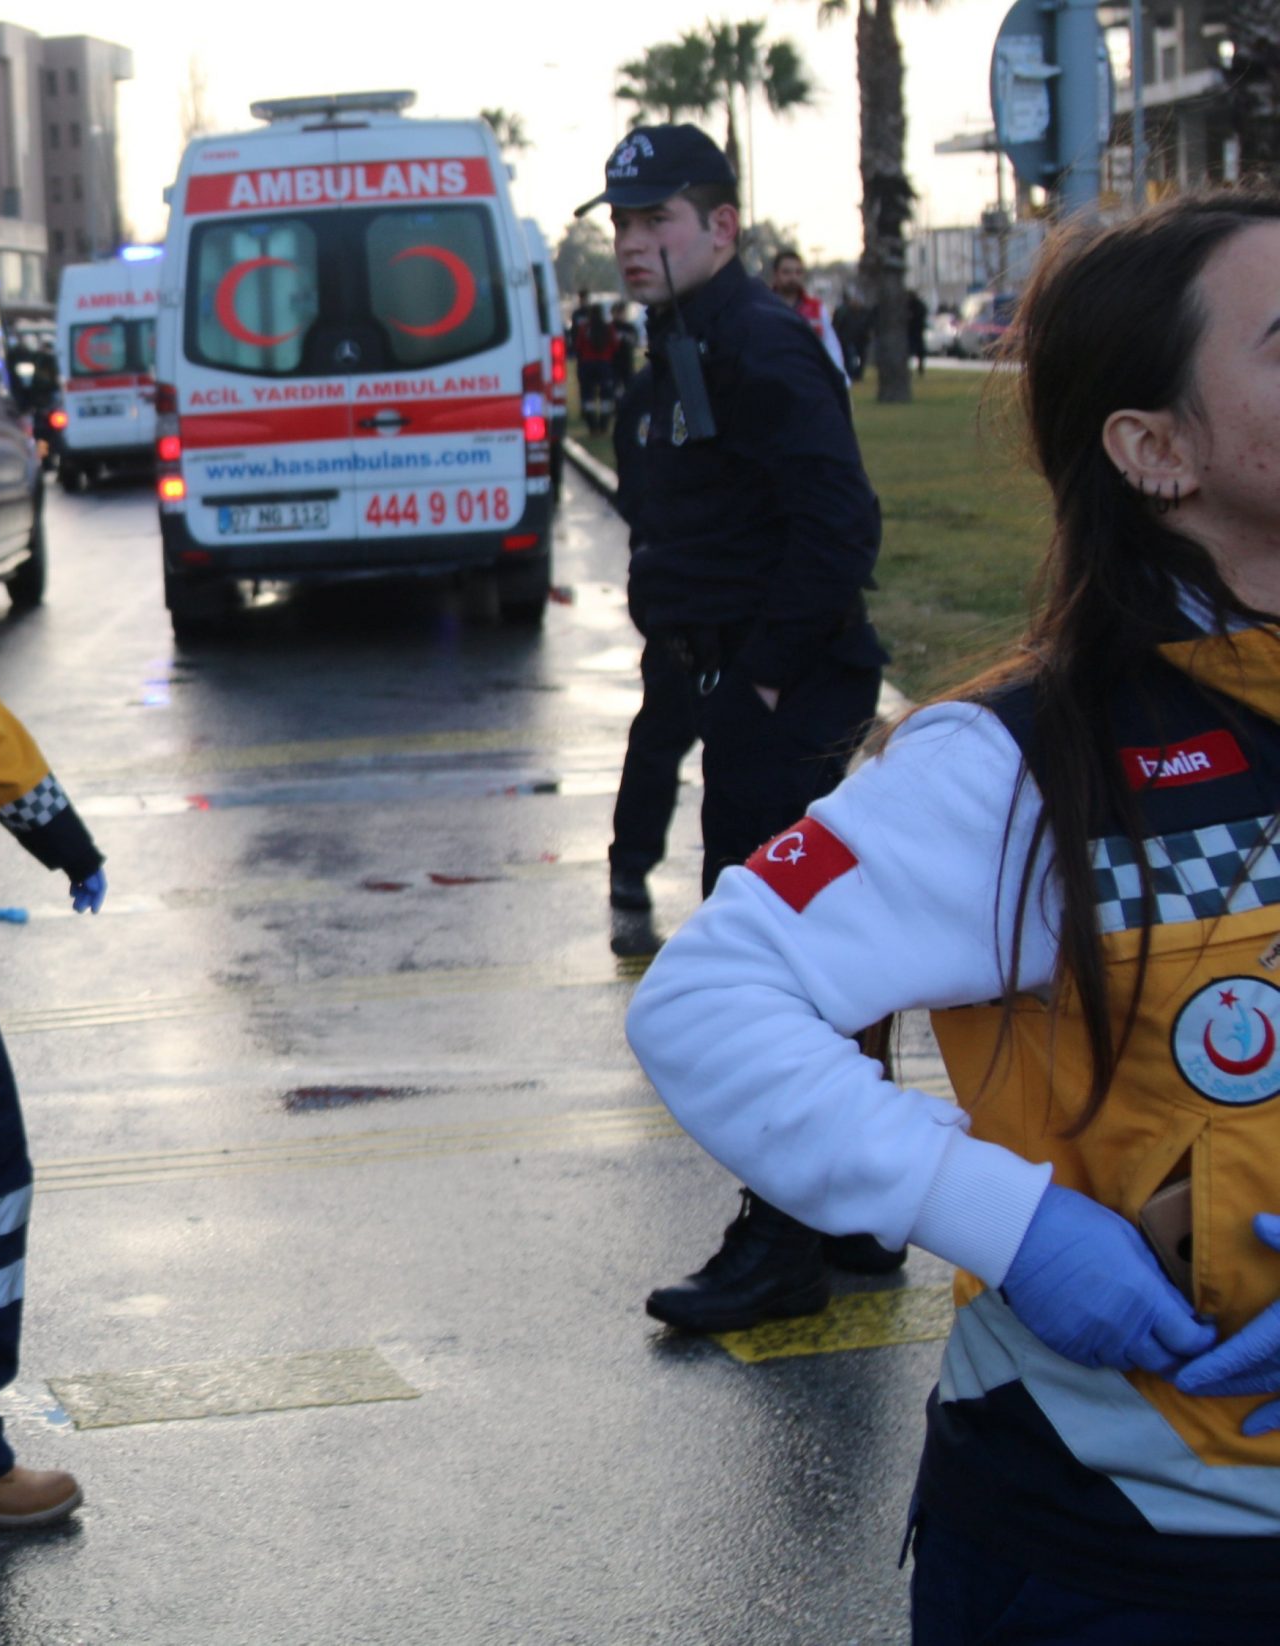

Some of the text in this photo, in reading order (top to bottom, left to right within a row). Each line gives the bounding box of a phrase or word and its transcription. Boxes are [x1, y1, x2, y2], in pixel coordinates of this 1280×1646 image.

[229, 160, 466, 208] AMBULANS
[76, 288, 161, 311] AMBULA
[190, 375, 500, 406] ACİL YARDIM AMBULANSI
[206, 448, 491, 480] www.hasambulans.com
[366, 486, 510, 527] 444 9 018
[1137, 751, 1211, 778] İZMİR
